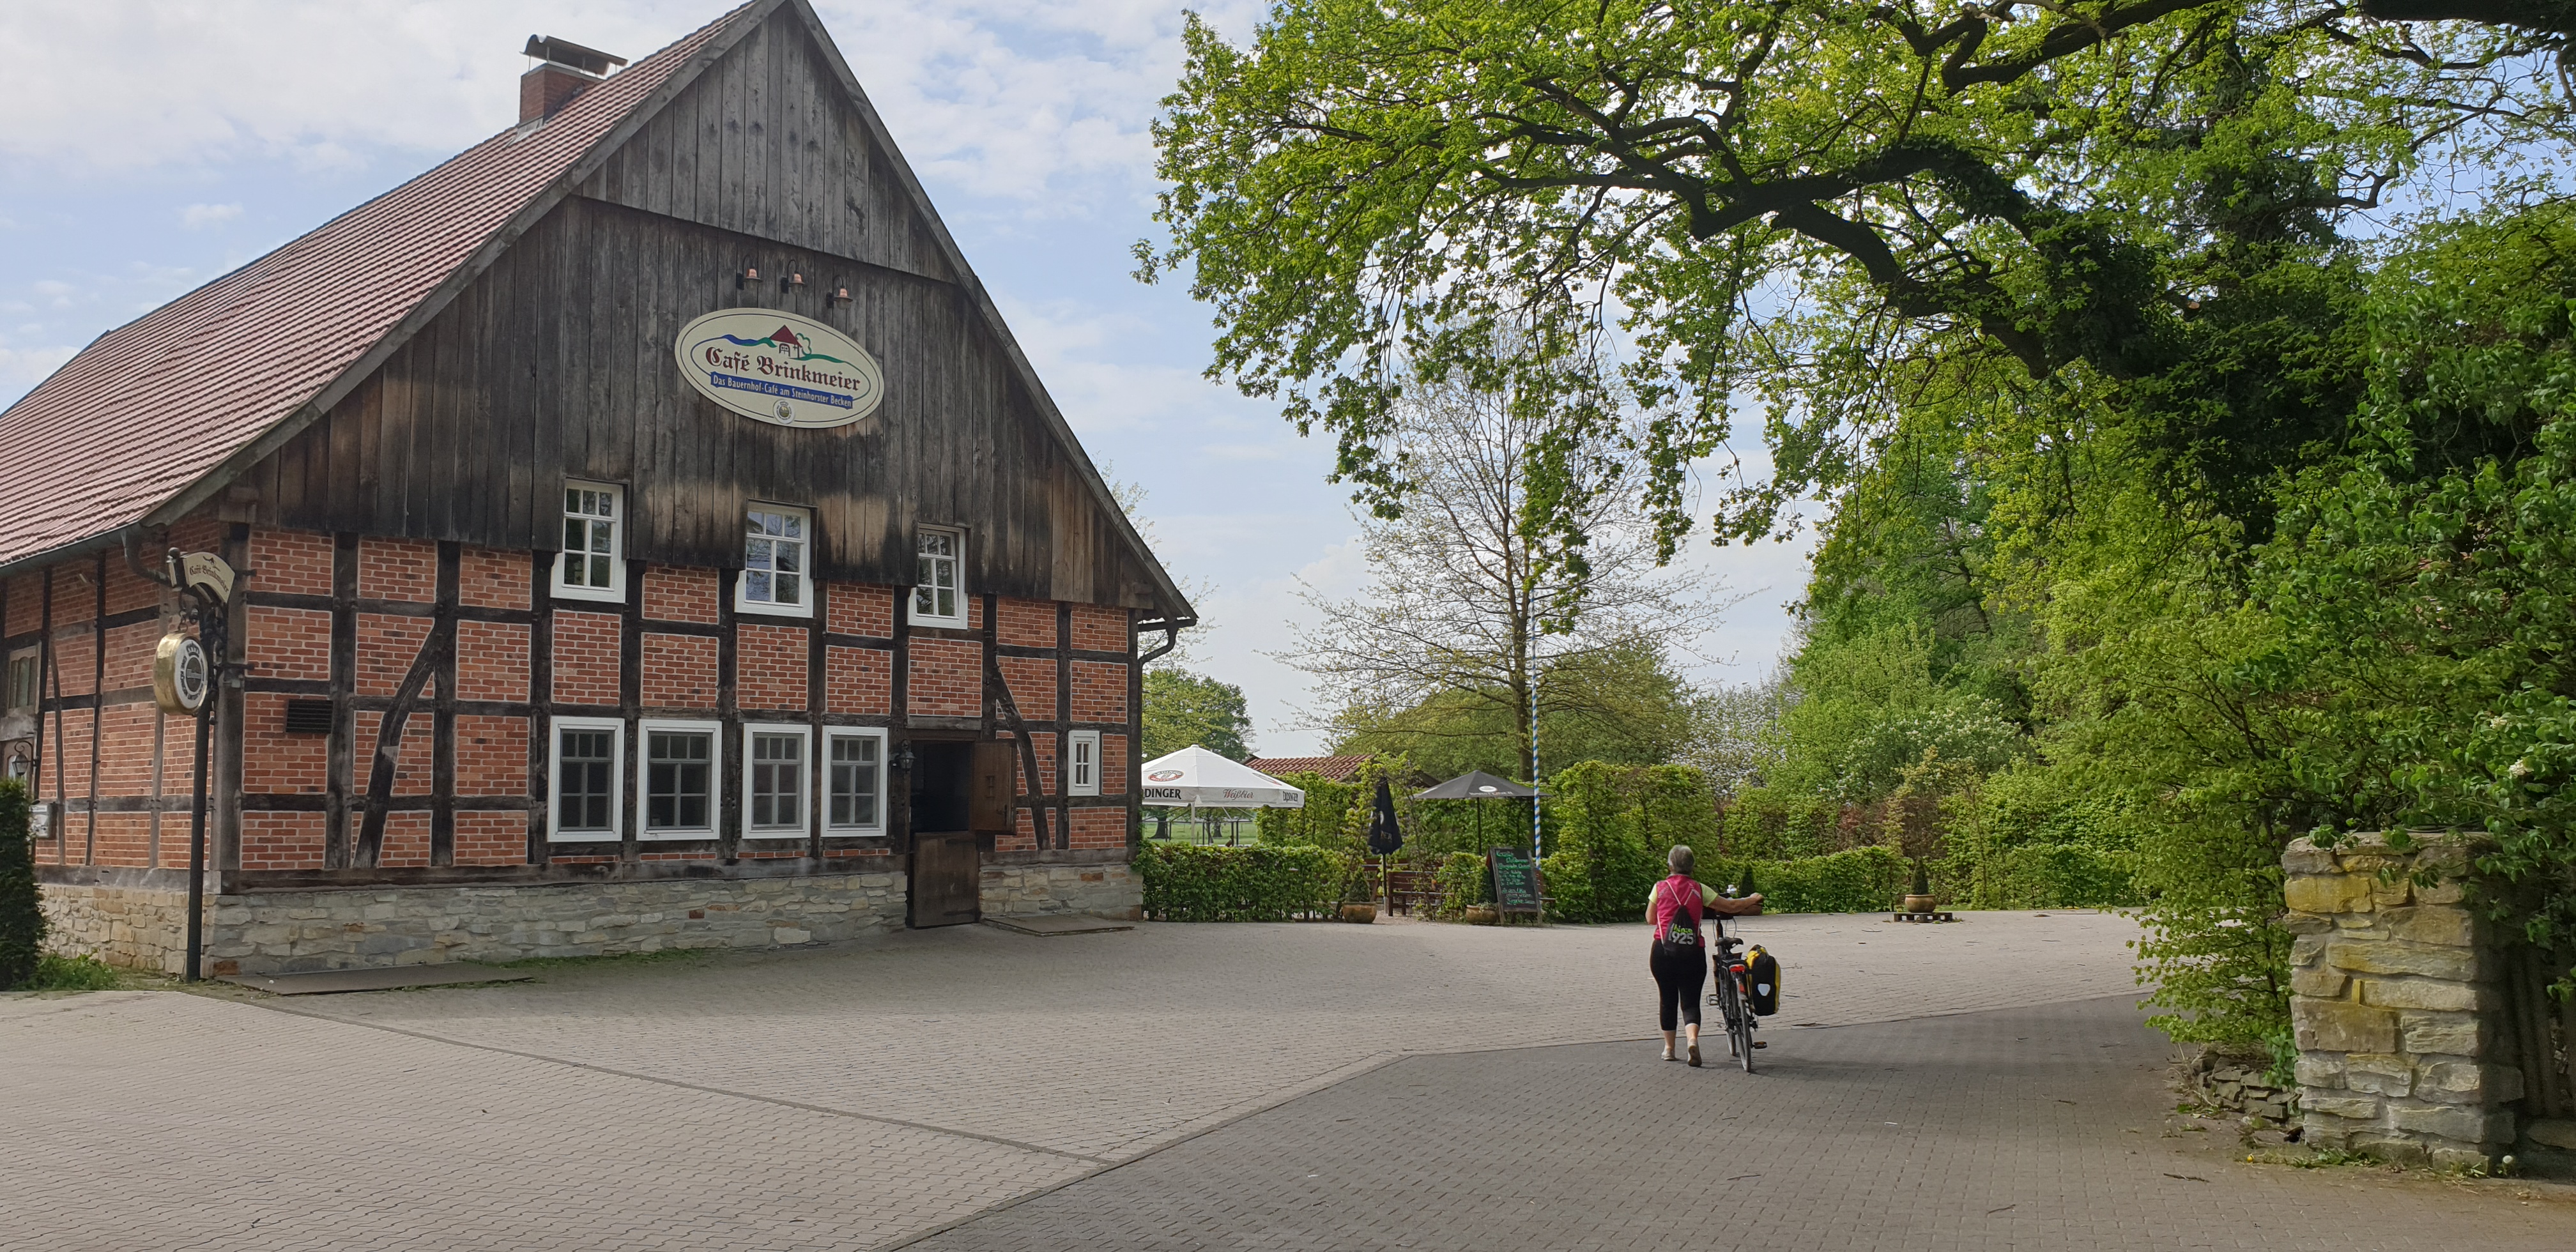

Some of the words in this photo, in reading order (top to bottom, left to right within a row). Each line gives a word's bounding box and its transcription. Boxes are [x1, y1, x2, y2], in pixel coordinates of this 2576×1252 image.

[705, 347, 750, 375] Café
[756, 355, 861, 391] Brinkmeier
[713, 374, 726, 385] Das
[728, 377, 778, 394] Bauernhof-Café
[792, 388, 829, 404] Steinhorster
[831, 395, 852, 408] Becken
[1144, 788, 1181, 800] DINGER
[1223, 789, 1254, 800] Weißbier
